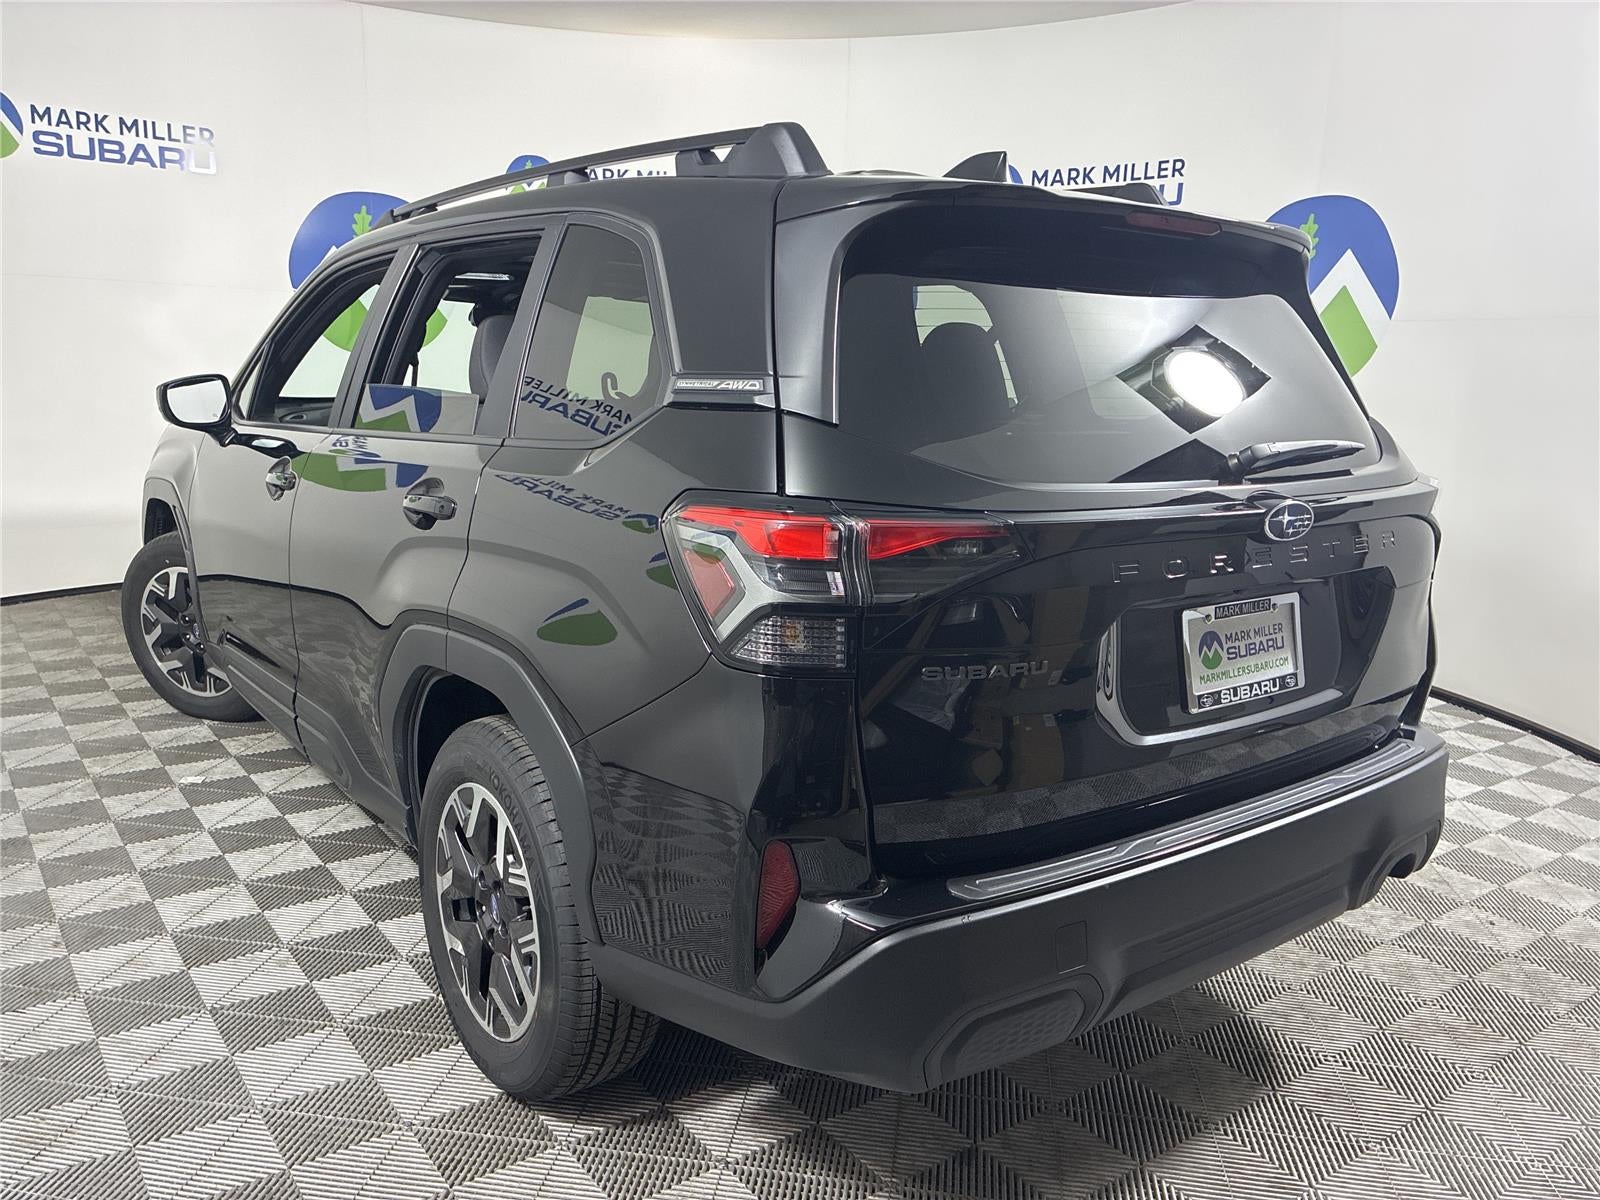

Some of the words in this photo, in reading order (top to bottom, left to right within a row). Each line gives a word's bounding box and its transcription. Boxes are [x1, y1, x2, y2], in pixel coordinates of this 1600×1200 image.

[30, 103, 111, 134] MARK
[118, 116, 215, 147] MILLER
[32, 130, 216, 175] SUBARU
[586, 167, 629, 182] ARK
[1031, 166, 1096, 187] MARK
[1102, 158, 1186, 183] MILLER
[717, 380, 760, 389] AWD
[1112, 530, 1397, 583] FORESTER
[1215, 605, 1240, 619] MARK
[1242, 600, 1270, 614] MILLER
[1224, 631, 1252, 645] MARK
[1253, 622, 1284, 640] MILLER
[1226, 636, 1285, 661] SUBARU
[921, 660, 1049, 681] SUBARU
[1199, 656, 1290, 685] MARKMILLERSUBARU.COM
[1220, 678, 1280, 703] SUBARU
